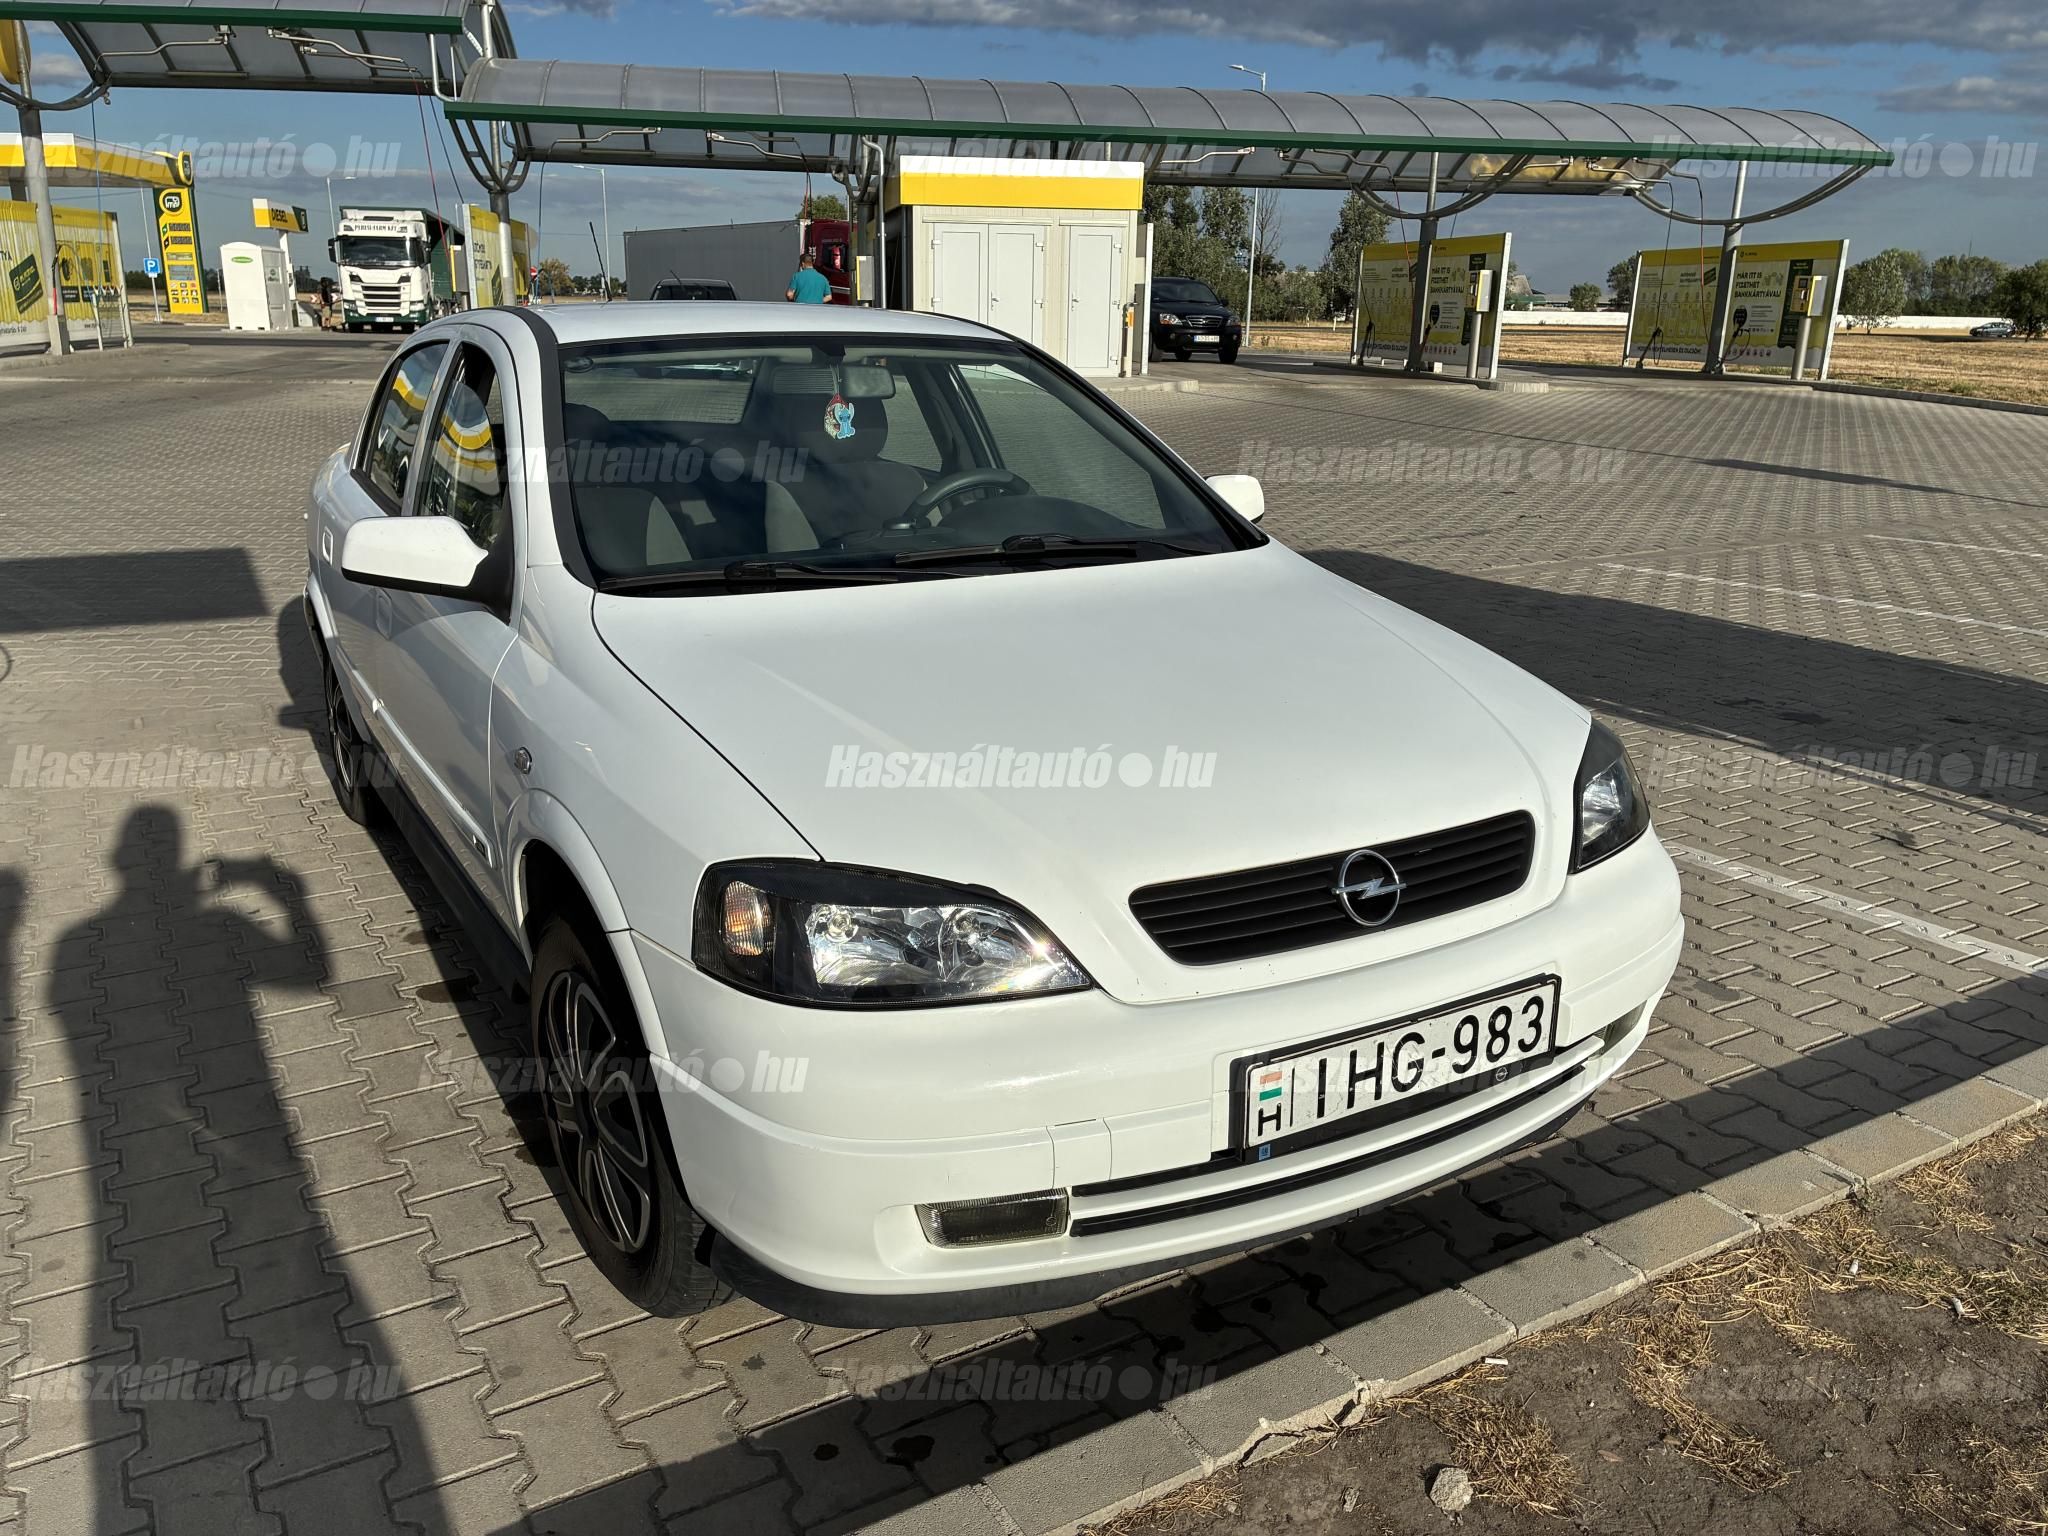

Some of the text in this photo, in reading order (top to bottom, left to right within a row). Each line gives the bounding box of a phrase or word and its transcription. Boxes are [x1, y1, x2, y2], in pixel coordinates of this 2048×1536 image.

[271, 208, 288, 223] DIESEL
[147, 260, 156, 271] P
[1316, 996, 1545, 1119] IHG-983
[1257, 1102, 1282, 1137] H
